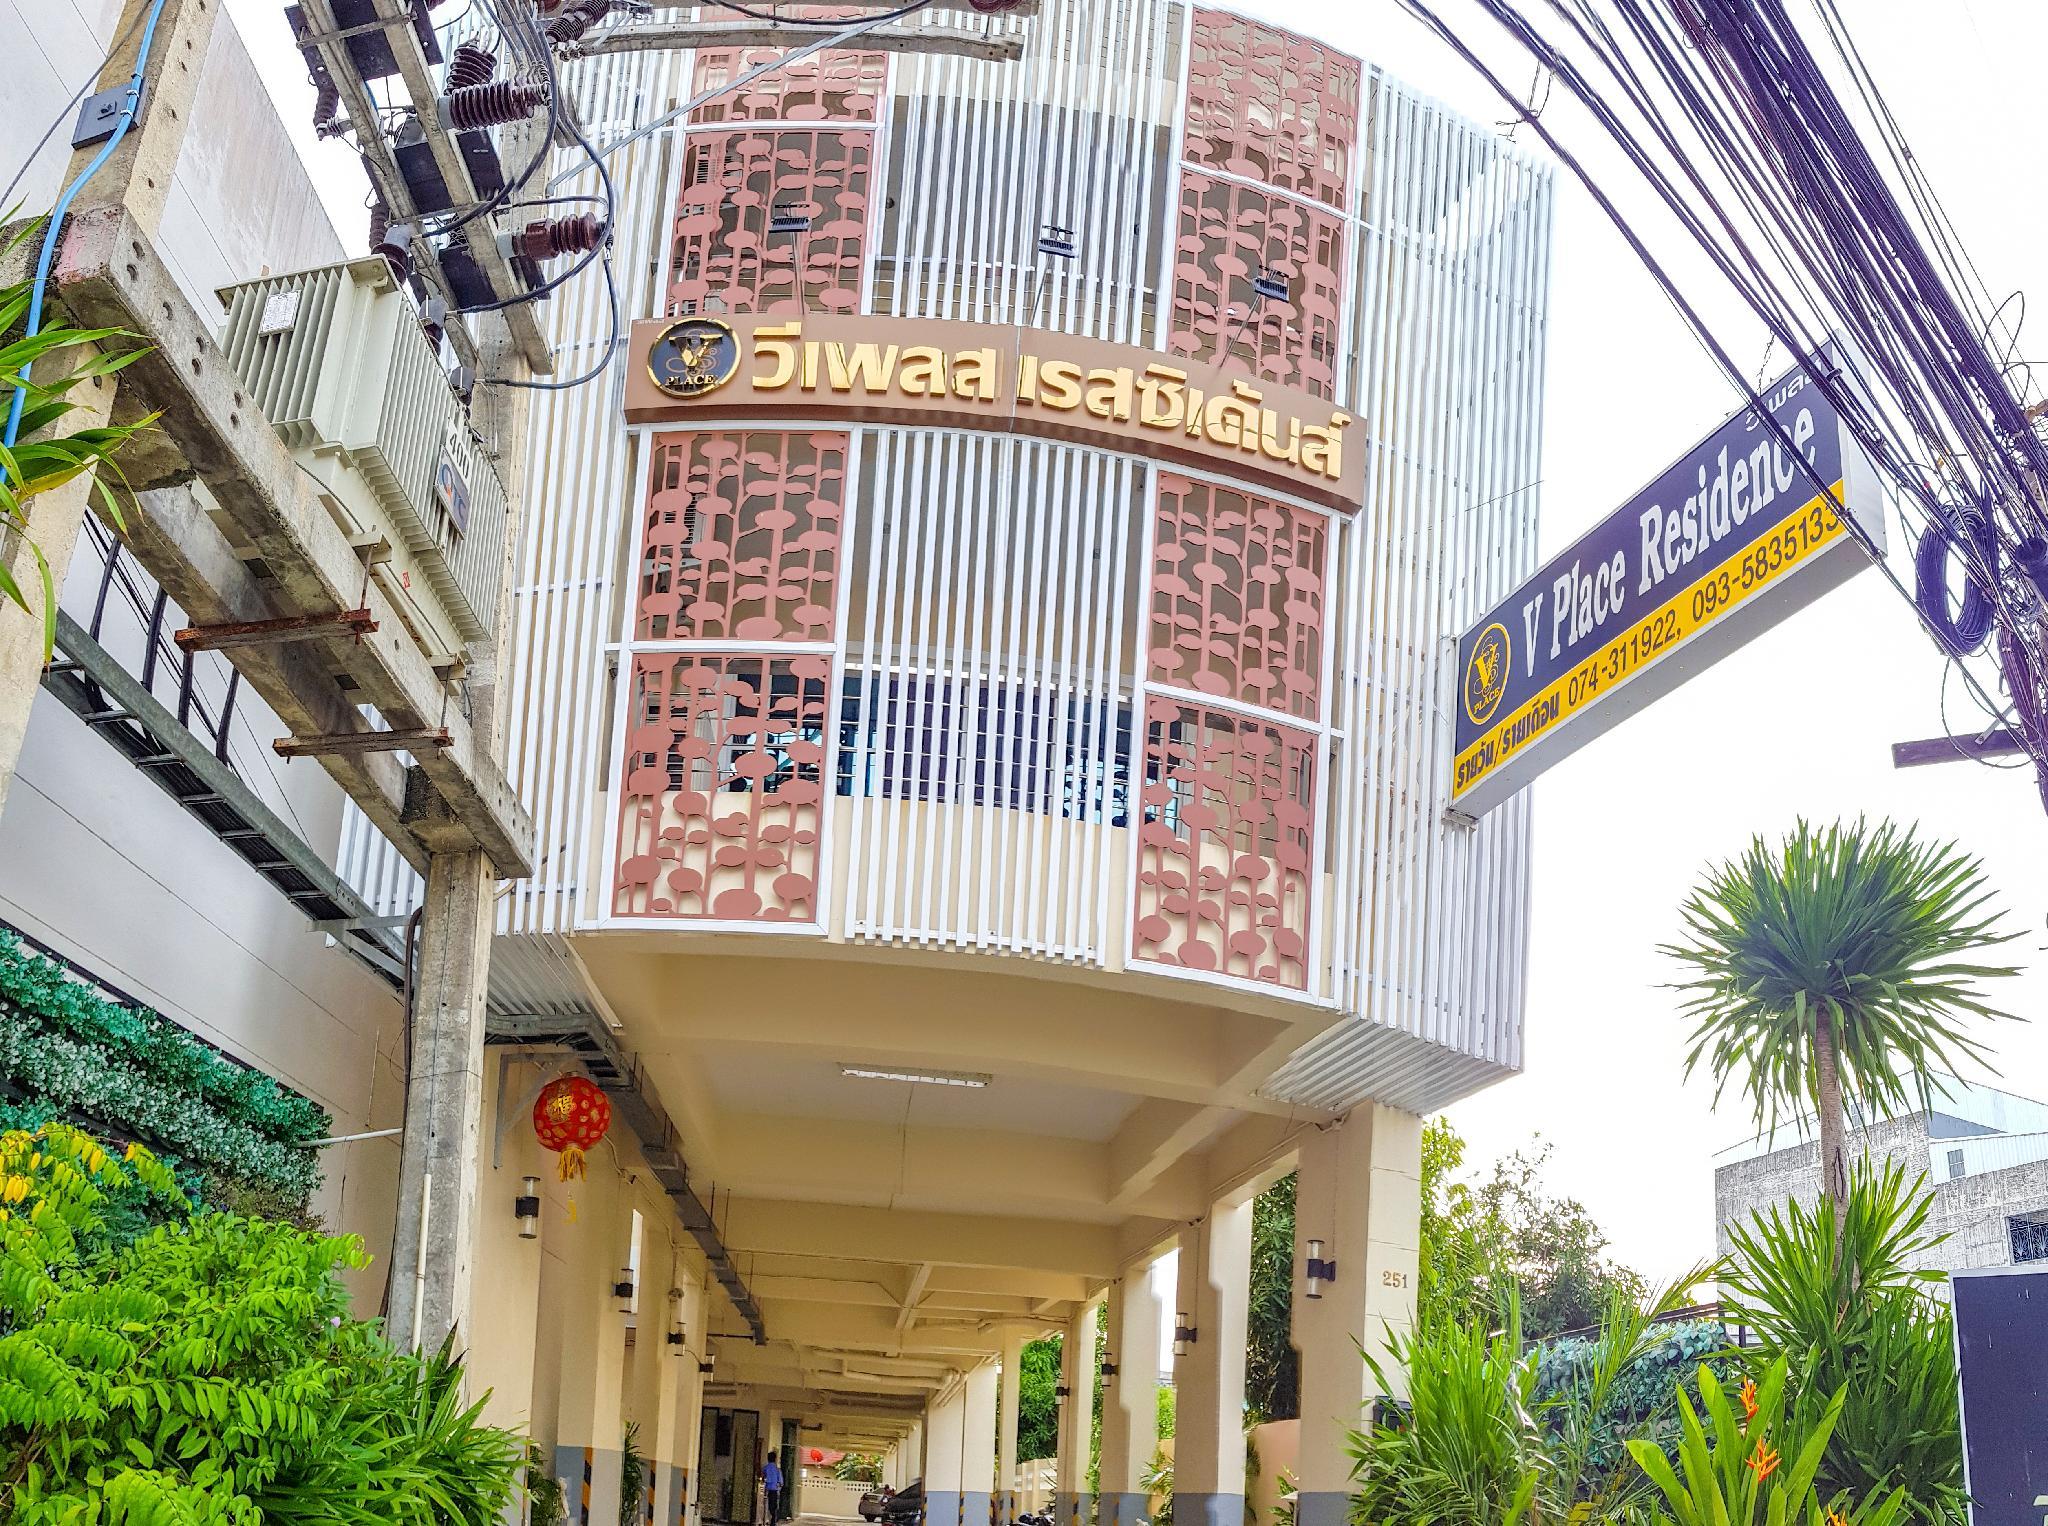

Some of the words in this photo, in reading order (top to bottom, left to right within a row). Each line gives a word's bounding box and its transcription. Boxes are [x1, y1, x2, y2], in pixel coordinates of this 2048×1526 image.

[666, 374, 716, 388] PLACE
[752, 321, 997, 402] วีเพลส
[449, 432, 470, 479] 400
[1523, 594, 1544, 678] V
[1551, 551, 1627, 661] Place
[1638, 407, 1816, 597] Residence
[1568, 609, 1681, 707] 074-311922,
[1474, 686, 1503, 714] PLACE
[1383, 1270, 1408, 1289] 251
